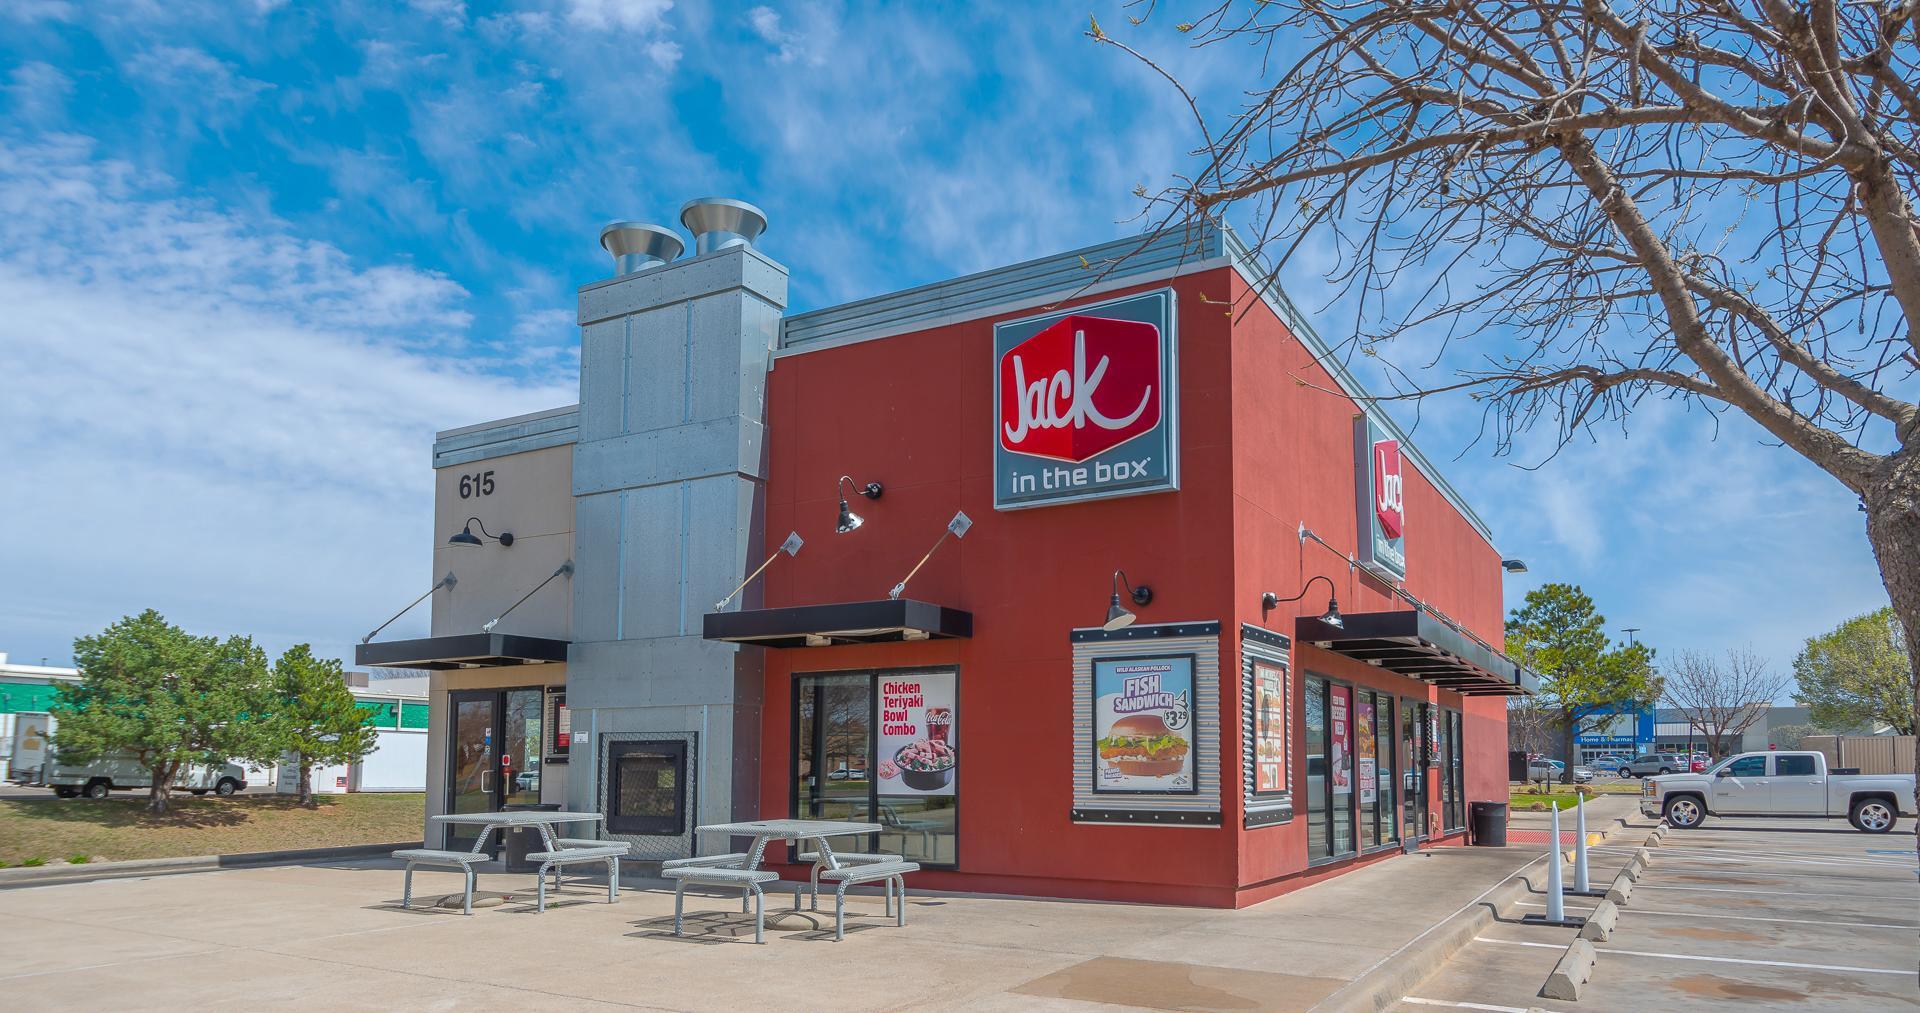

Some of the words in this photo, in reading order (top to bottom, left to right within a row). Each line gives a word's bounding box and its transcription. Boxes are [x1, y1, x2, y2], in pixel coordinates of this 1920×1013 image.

[1005, 330, 1151, 443] Jack
[460, 471, 495, 499] 615
[1013, 472, 1035, 493] in
[1043, 467, 1087, 489] the
[1096, 461, 1148, 482] box
[883, 682, 920, 694] Chicken
[1126, 675, 1160, 697] FISH
[883, 695, 923, 709] Teriyaki
[1115, 693, 1173, 710] SANDWICH
[883, 710, 908, 721] Bowl
[882, 723, 916, 735] Combo
